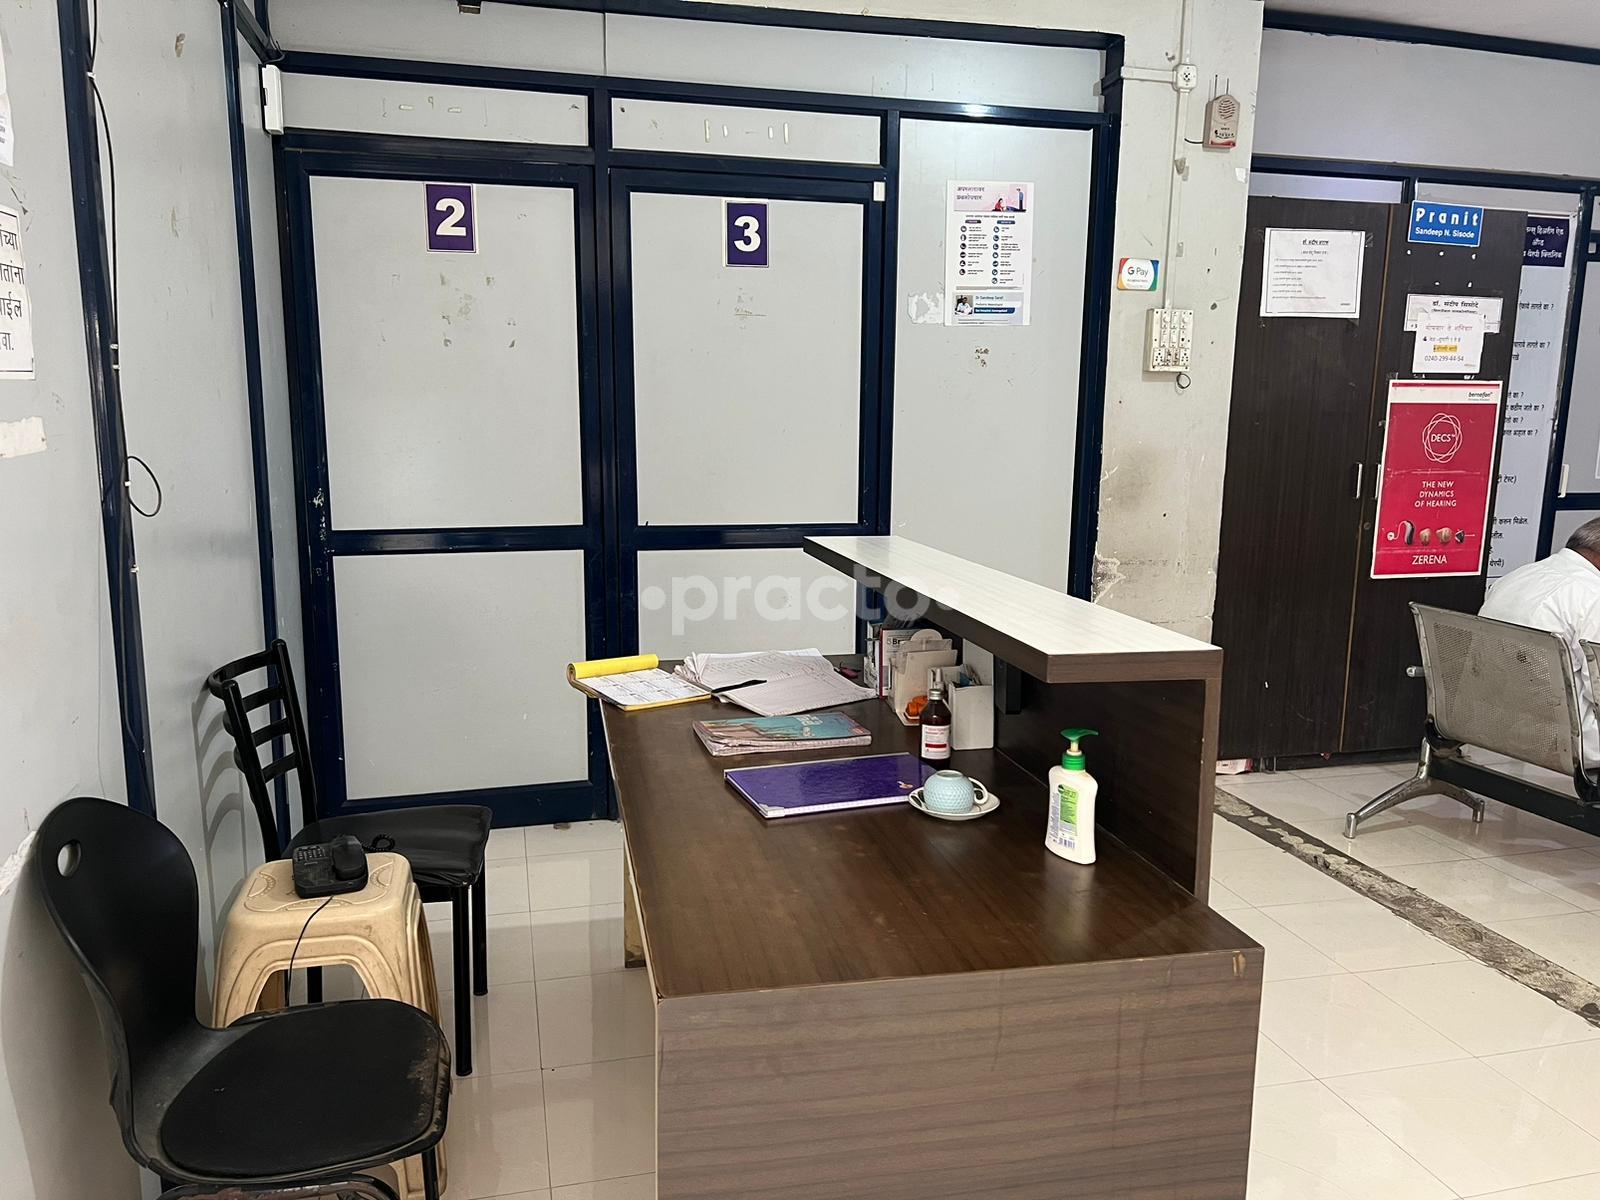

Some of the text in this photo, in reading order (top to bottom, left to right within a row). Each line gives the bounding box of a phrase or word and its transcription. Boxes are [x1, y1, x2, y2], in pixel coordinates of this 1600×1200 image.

[434, 197, 467, 236] 2
[1415, 207, 1479, 226] Pranit
[733, 215, 762, 252] 3
[1415, 227, 1443, 237] Sandeep
[1452, 230, 1475, 238] Sisode
[1127, 266, 1149, 277] G Pay
[1422, 480, 1454, 488] THE NEW
[1420, 490, 1454, 498] DYNAMICS
[1414, 500, 1457, 508] OF HEARING
[1411, 554, 1448, 565] ZERENA
